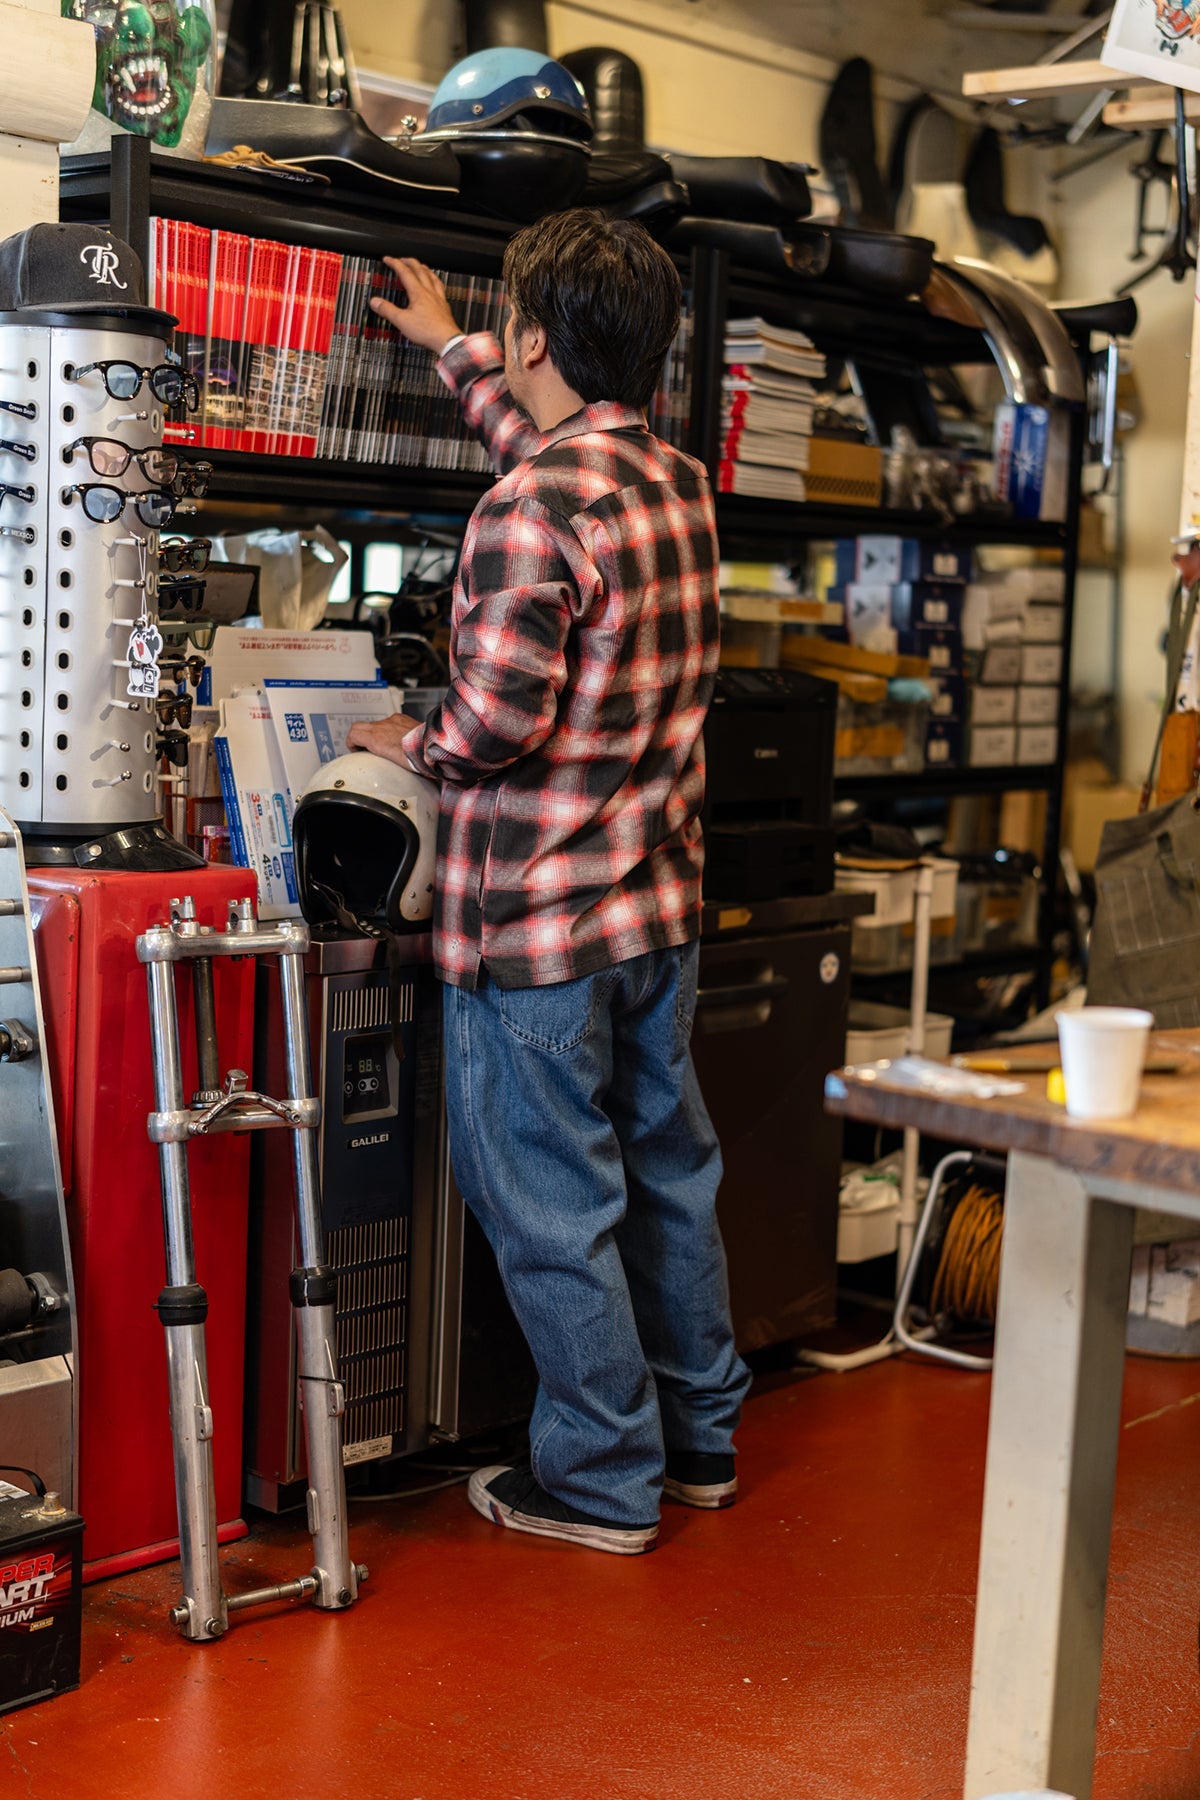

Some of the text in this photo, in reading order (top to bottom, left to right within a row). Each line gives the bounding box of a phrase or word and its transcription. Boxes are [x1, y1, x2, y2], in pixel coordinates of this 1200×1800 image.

[8, 403, 23, 413] Green
[13, 444, 27, 455] Green
[287, 720, 305, 728] ライト
[290, 728, 307, 739] 430
[351, 1133, 389, 1148] GALILEI
[0, 1553, 55, 1587] PER
[0, 1606, 35, 1628] IUM
